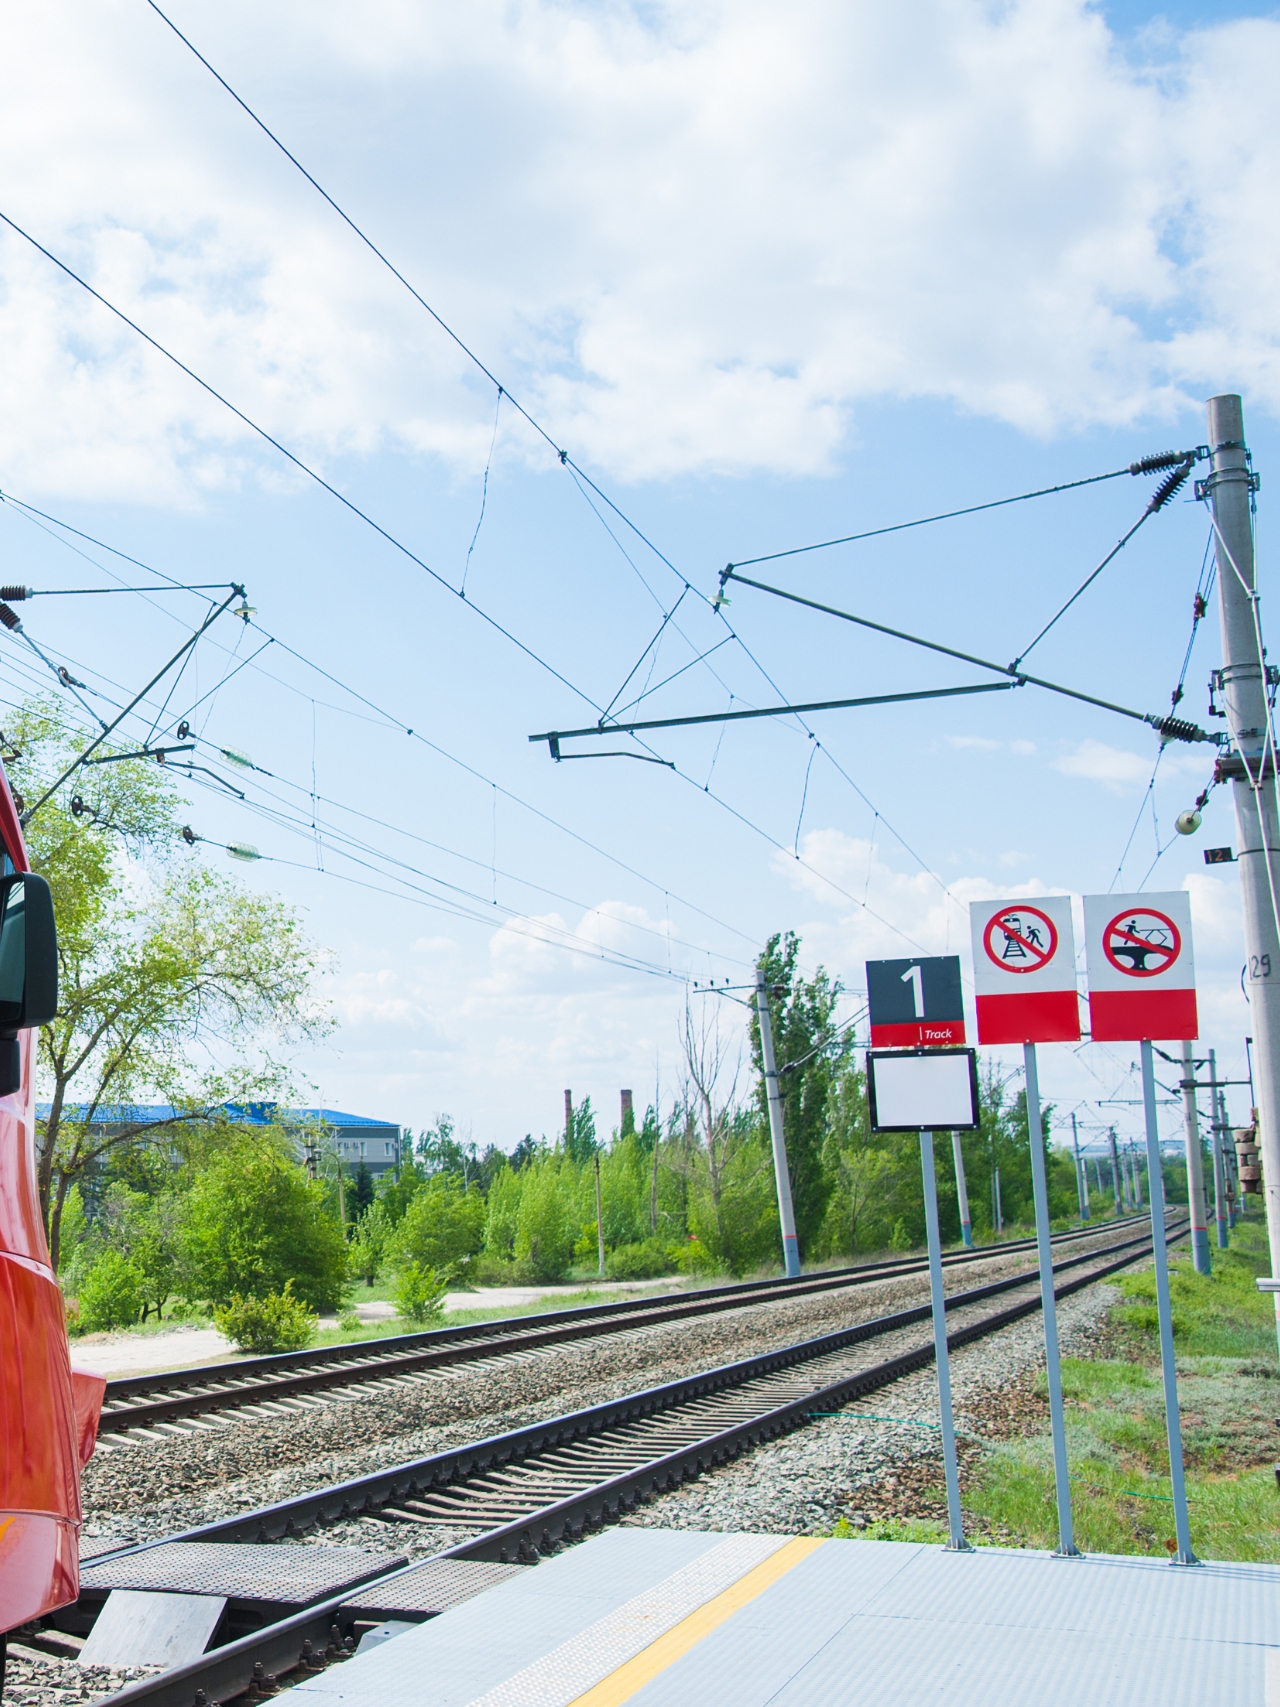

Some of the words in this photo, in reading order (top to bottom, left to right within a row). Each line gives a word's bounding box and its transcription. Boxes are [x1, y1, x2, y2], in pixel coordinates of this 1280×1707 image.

[1248, 953, 1271, 980] 129
[900, 965, 924, 1017] 1
[924, 1028, 952, 1039] Track
